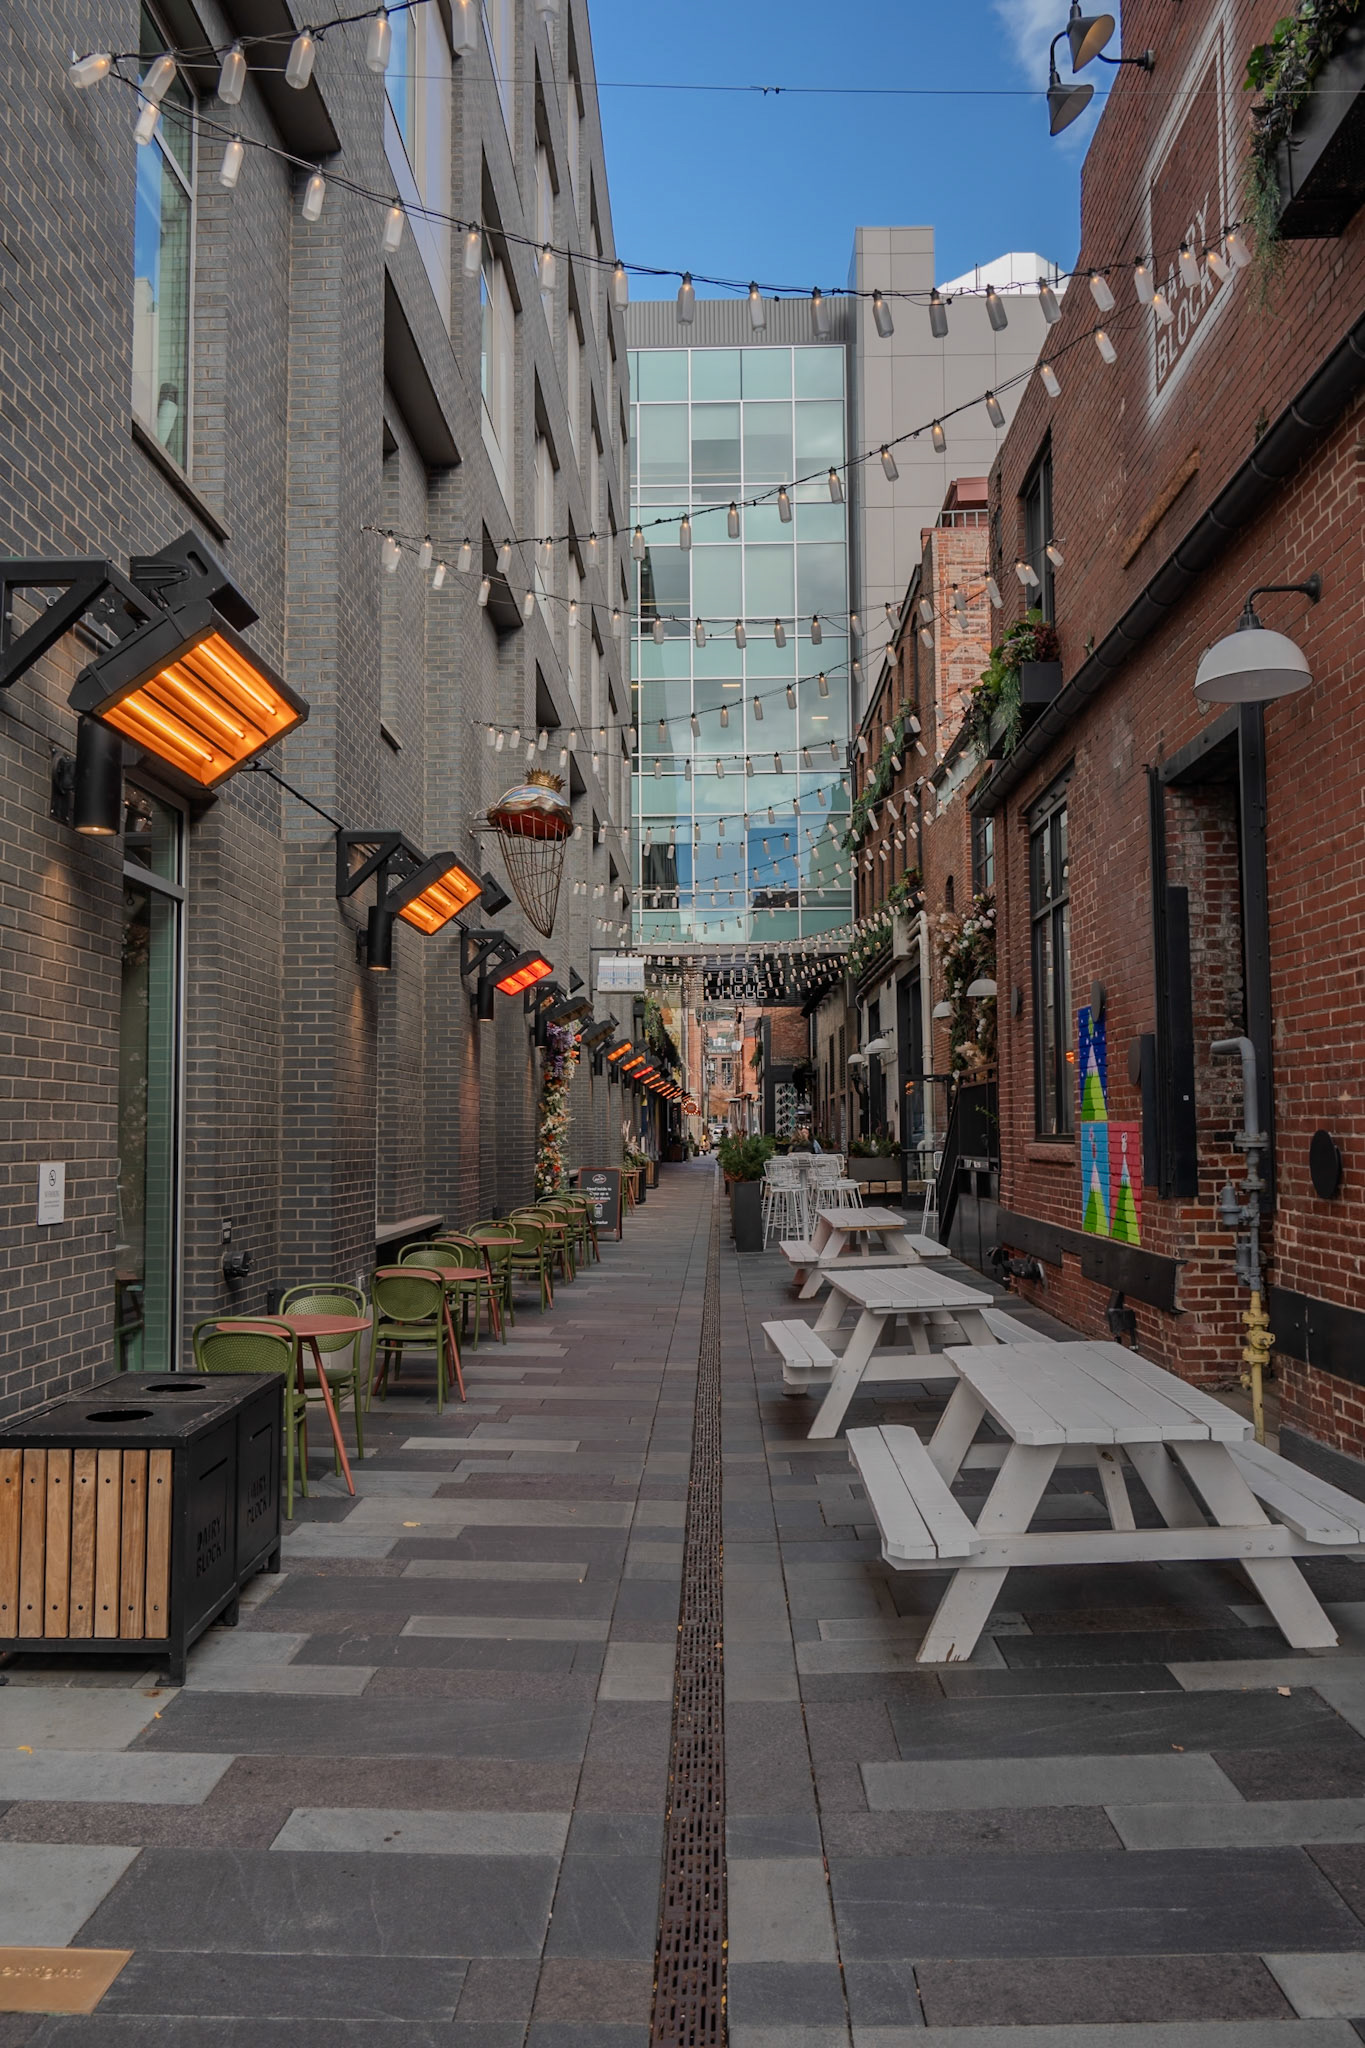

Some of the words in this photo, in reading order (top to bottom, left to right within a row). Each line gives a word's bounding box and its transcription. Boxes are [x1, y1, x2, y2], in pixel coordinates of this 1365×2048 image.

[1157, 258, 1214, 384] BLOCK
[197, 1513, 222, 1552] DAIRY
[196, 1542, 222, 1577] BLOCK
